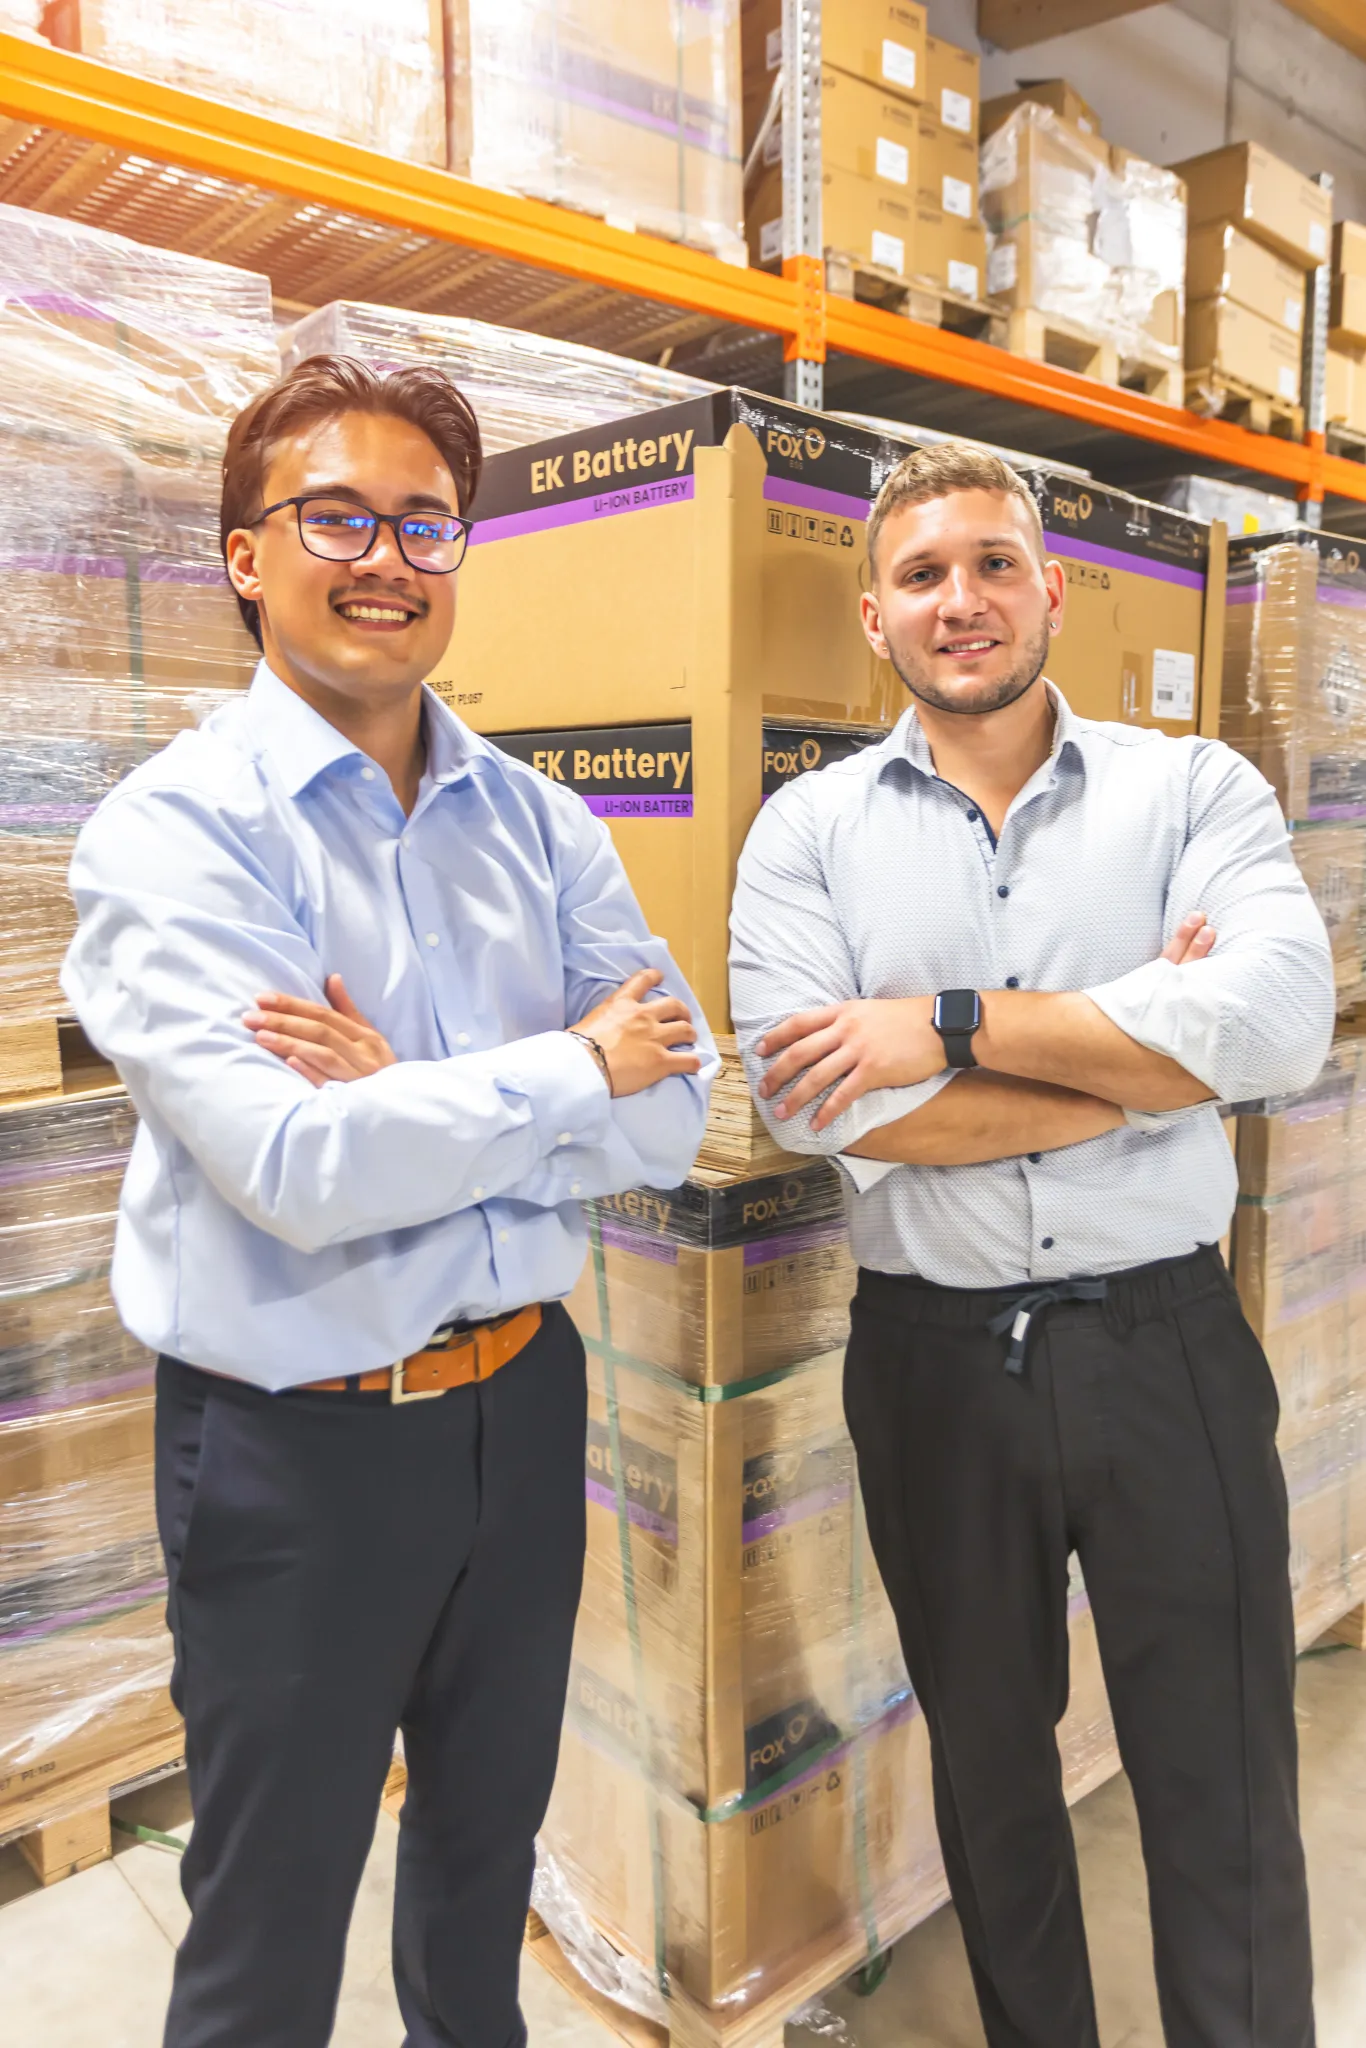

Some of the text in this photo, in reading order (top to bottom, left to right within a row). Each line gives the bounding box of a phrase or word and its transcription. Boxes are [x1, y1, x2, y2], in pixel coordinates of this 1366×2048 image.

[767, 430, 803, 460] FOX
[531, 429, 695, 494] EK Battery
[594, 481, 688, 512] LI-ION BATTERY
[1053, 497, 1078, 521] FOX
[533, 748, 691, 789] EK Battery
[764, 751, 799, 774] FOX
[605, 801, 693, 813] LI-ION BATTER
[743, 1196, 780, 1225] FOX
[750, 1736, 786, 1772] FOX
